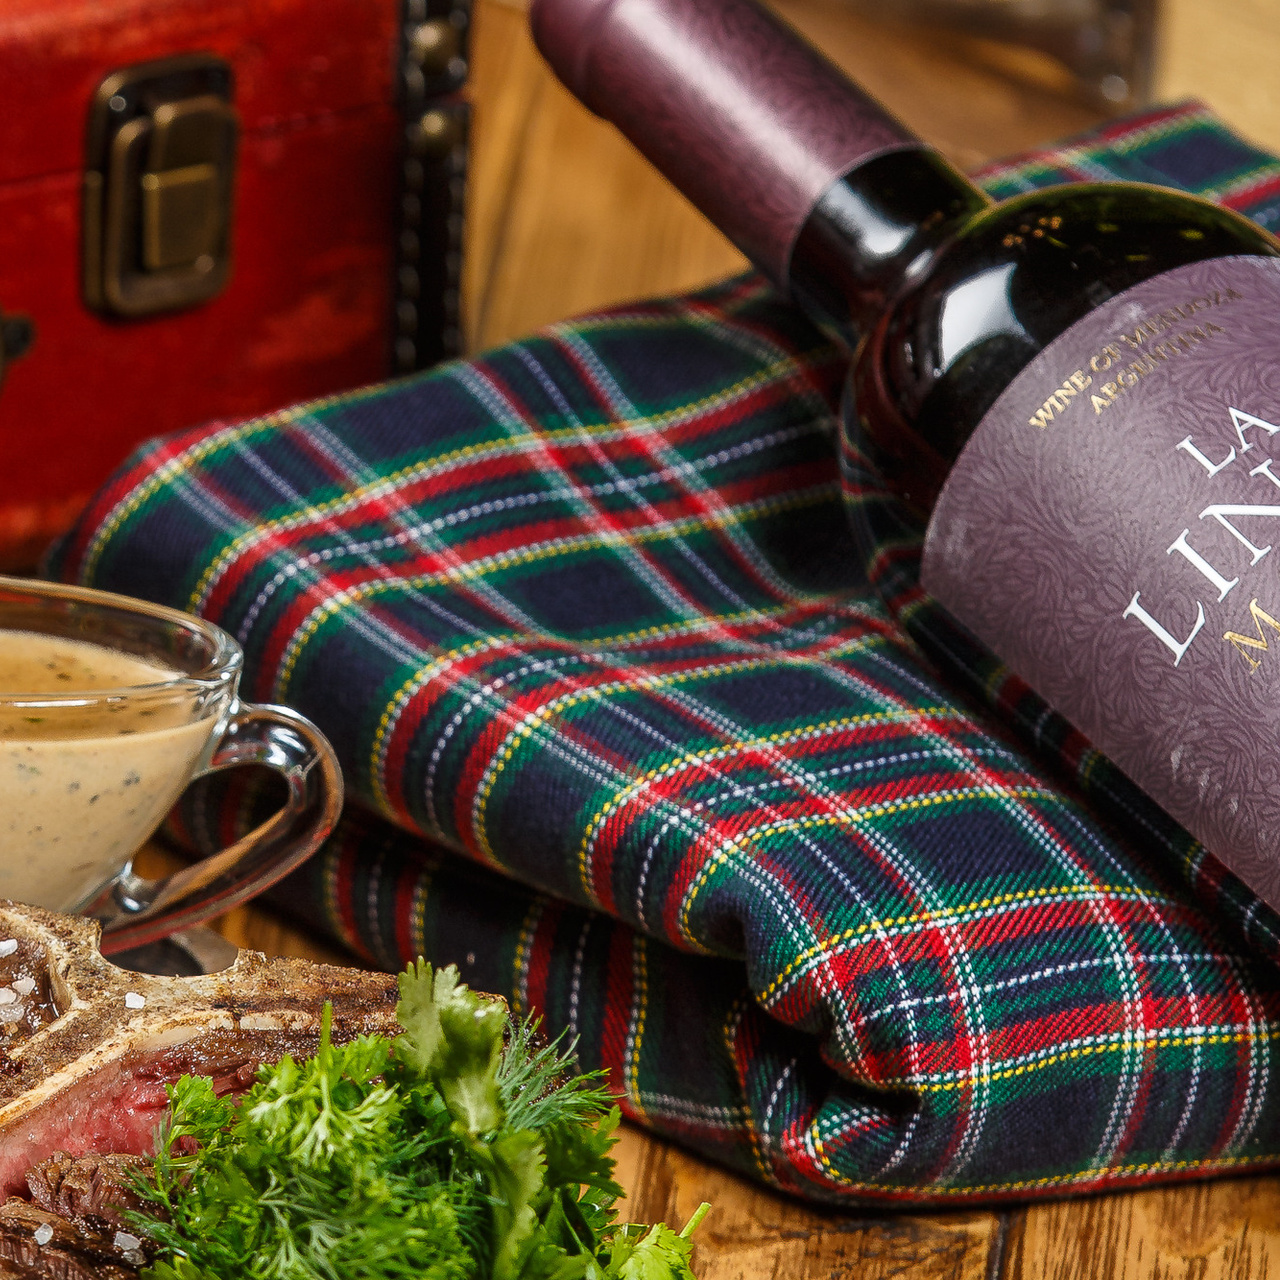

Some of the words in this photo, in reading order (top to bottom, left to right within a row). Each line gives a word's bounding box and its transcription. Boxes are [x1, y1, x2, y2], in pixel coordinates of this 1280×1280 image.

[1028, 369, 1093, 430] WINE
[1089, 341, 1122, 373] OF
[1121, 287, 1244, 350] MENDOZA
[1089, 321, 1226, 416] ARGENTINA
[1175, 406, 1280, 479] LA
